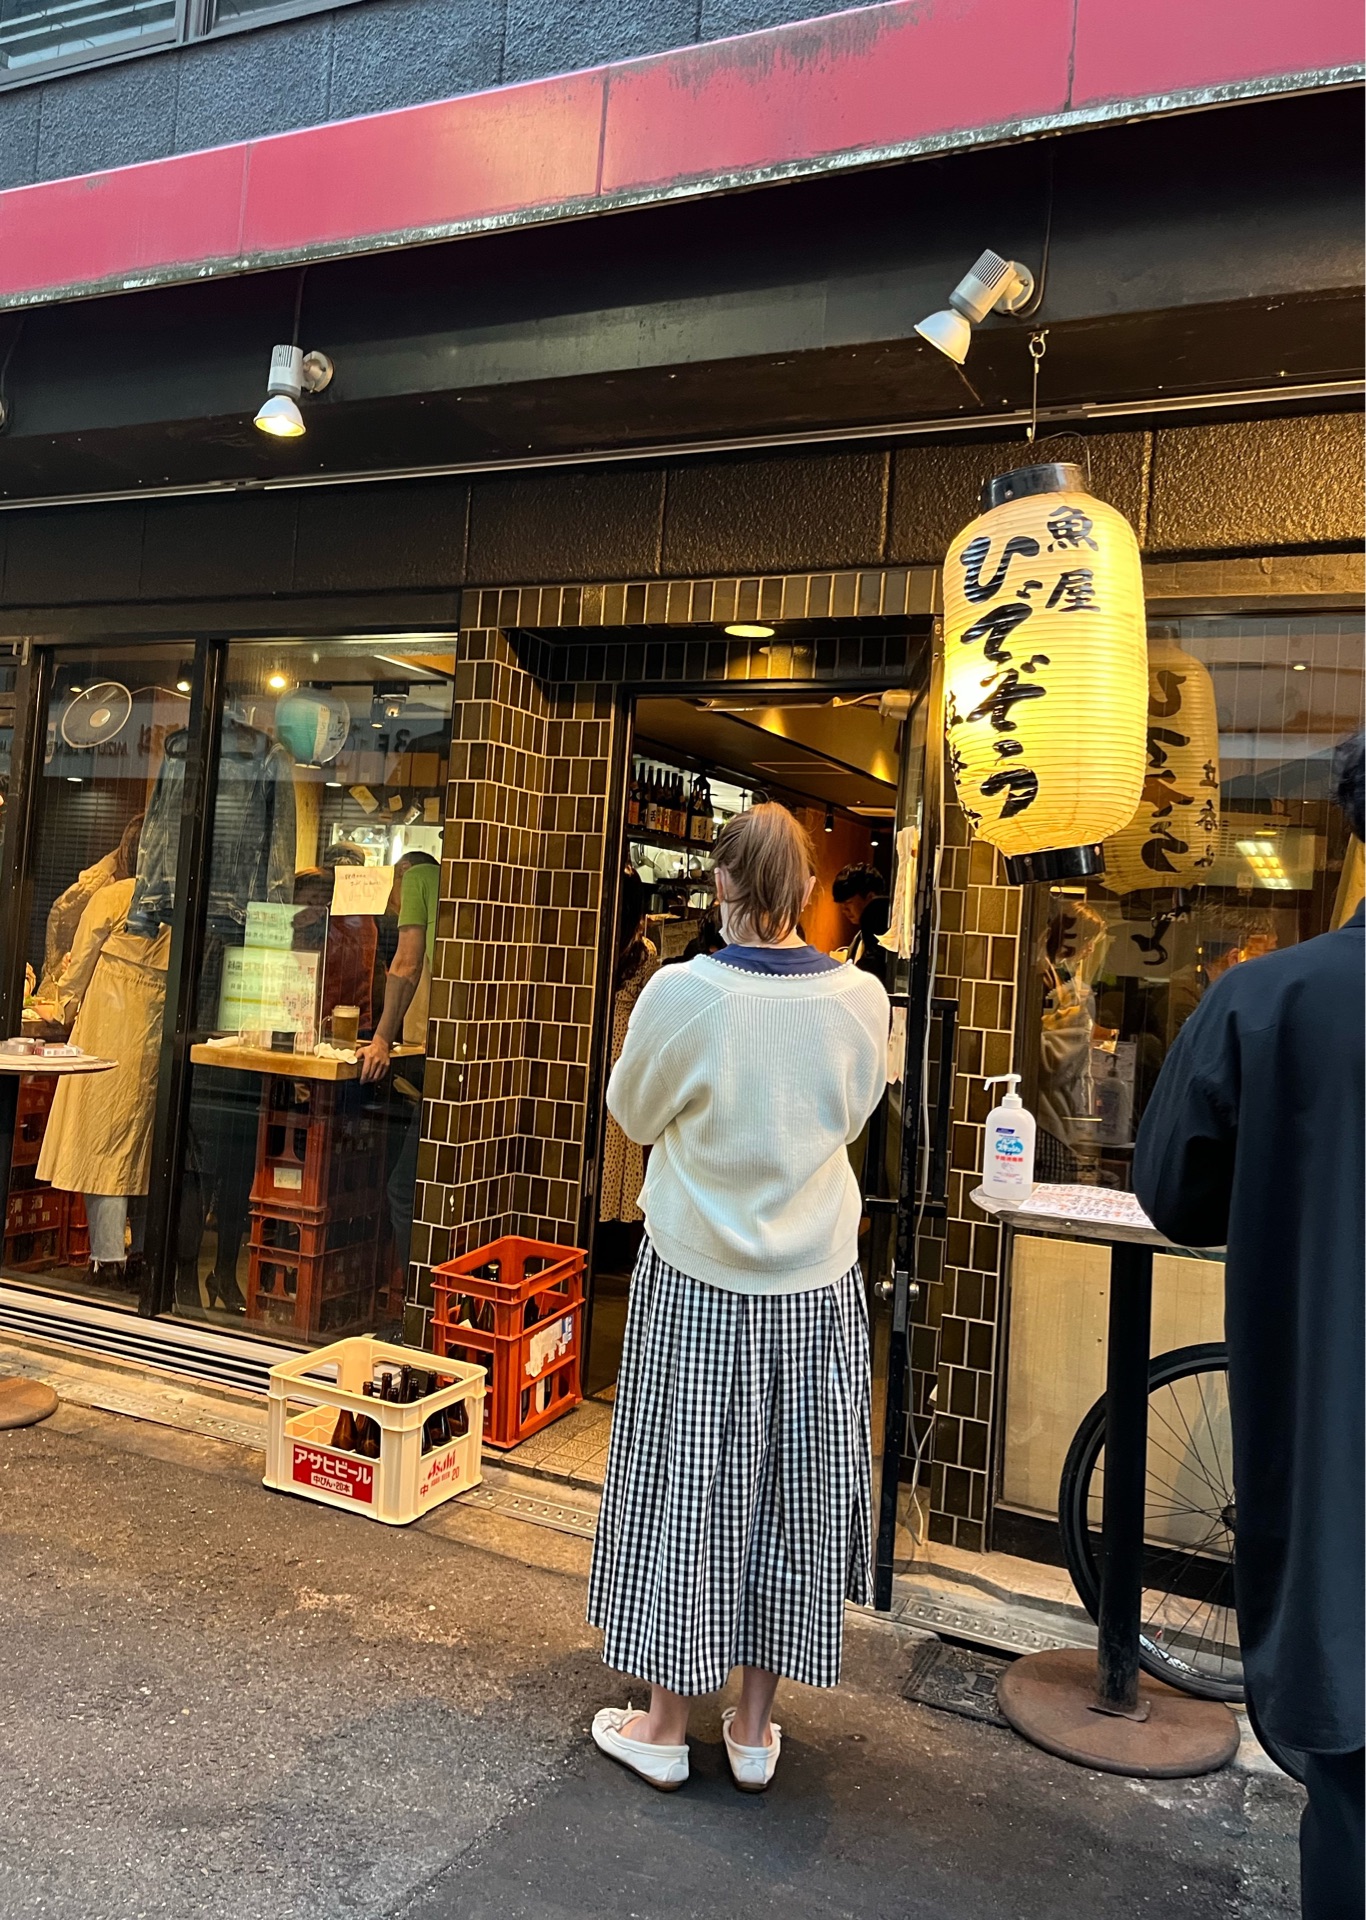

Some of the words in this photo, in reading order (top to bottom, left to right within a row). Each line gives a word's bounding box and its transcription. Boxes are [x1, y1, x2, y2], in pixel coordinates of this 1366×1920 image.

[1045, 505, 1101, 613] 魚屋
[959, 535, 1050, 820] ひでぞう
[294, 1447, 372, 1485] アサヒビール
[427, 1449, 457, 1480] Asahi
